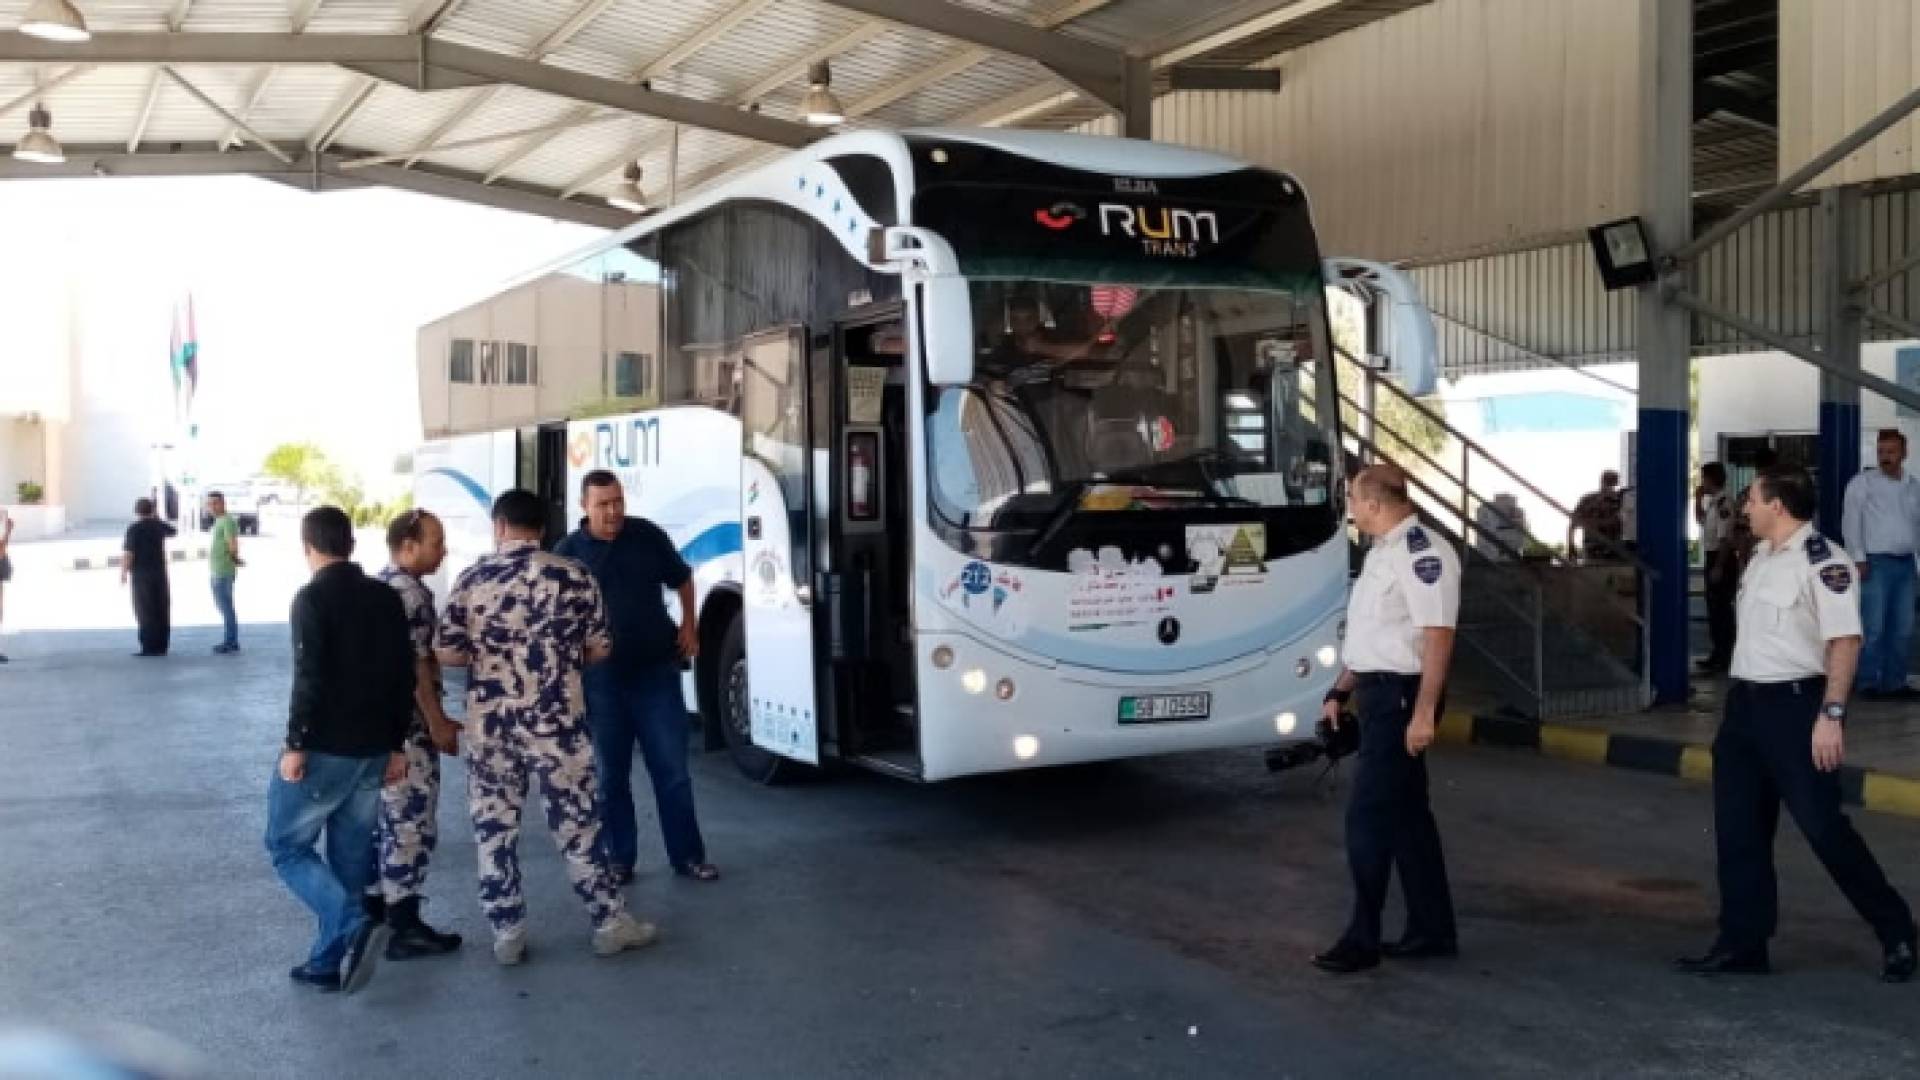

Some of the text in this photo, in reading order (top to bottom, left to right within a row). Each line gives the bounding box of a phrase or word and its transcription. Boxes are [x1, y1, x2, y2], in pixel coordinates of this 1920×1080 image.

[1099, 203, 1219, 243] RUM
[1142, 239, 1197, 258] TRANS
[595, 417, 660, 467] RUM
